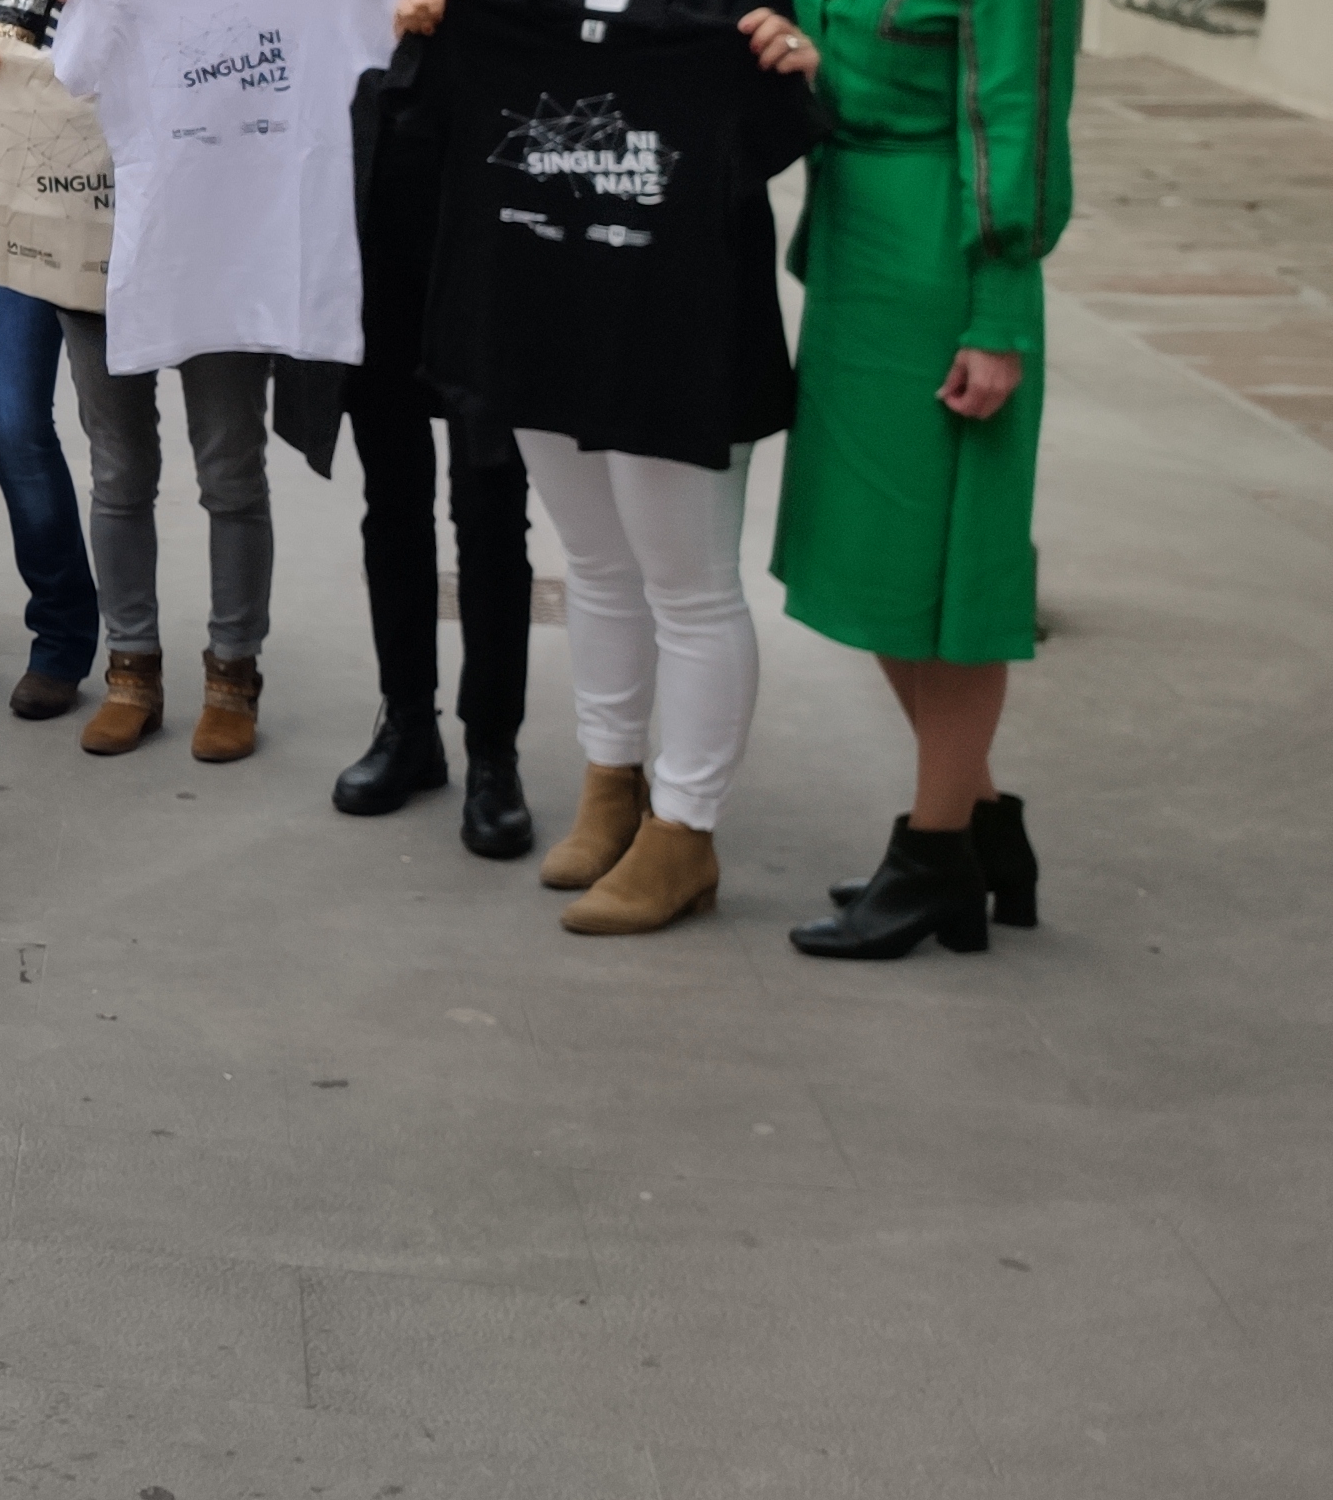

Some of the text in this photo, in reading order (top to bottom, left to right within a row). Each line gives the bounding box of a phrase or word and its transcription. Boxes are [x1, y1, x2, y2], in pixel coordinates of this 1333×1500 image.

[259, 29, 281, 46] NI
[184, 47, 285, 87] SINGULAR
[241, 66, 288, 90] NAIZ
[626, 131, 659, 150] NI
[527, 150, 660, 175] SINGULAR
[595, 173, 663, 194] NAIZ
